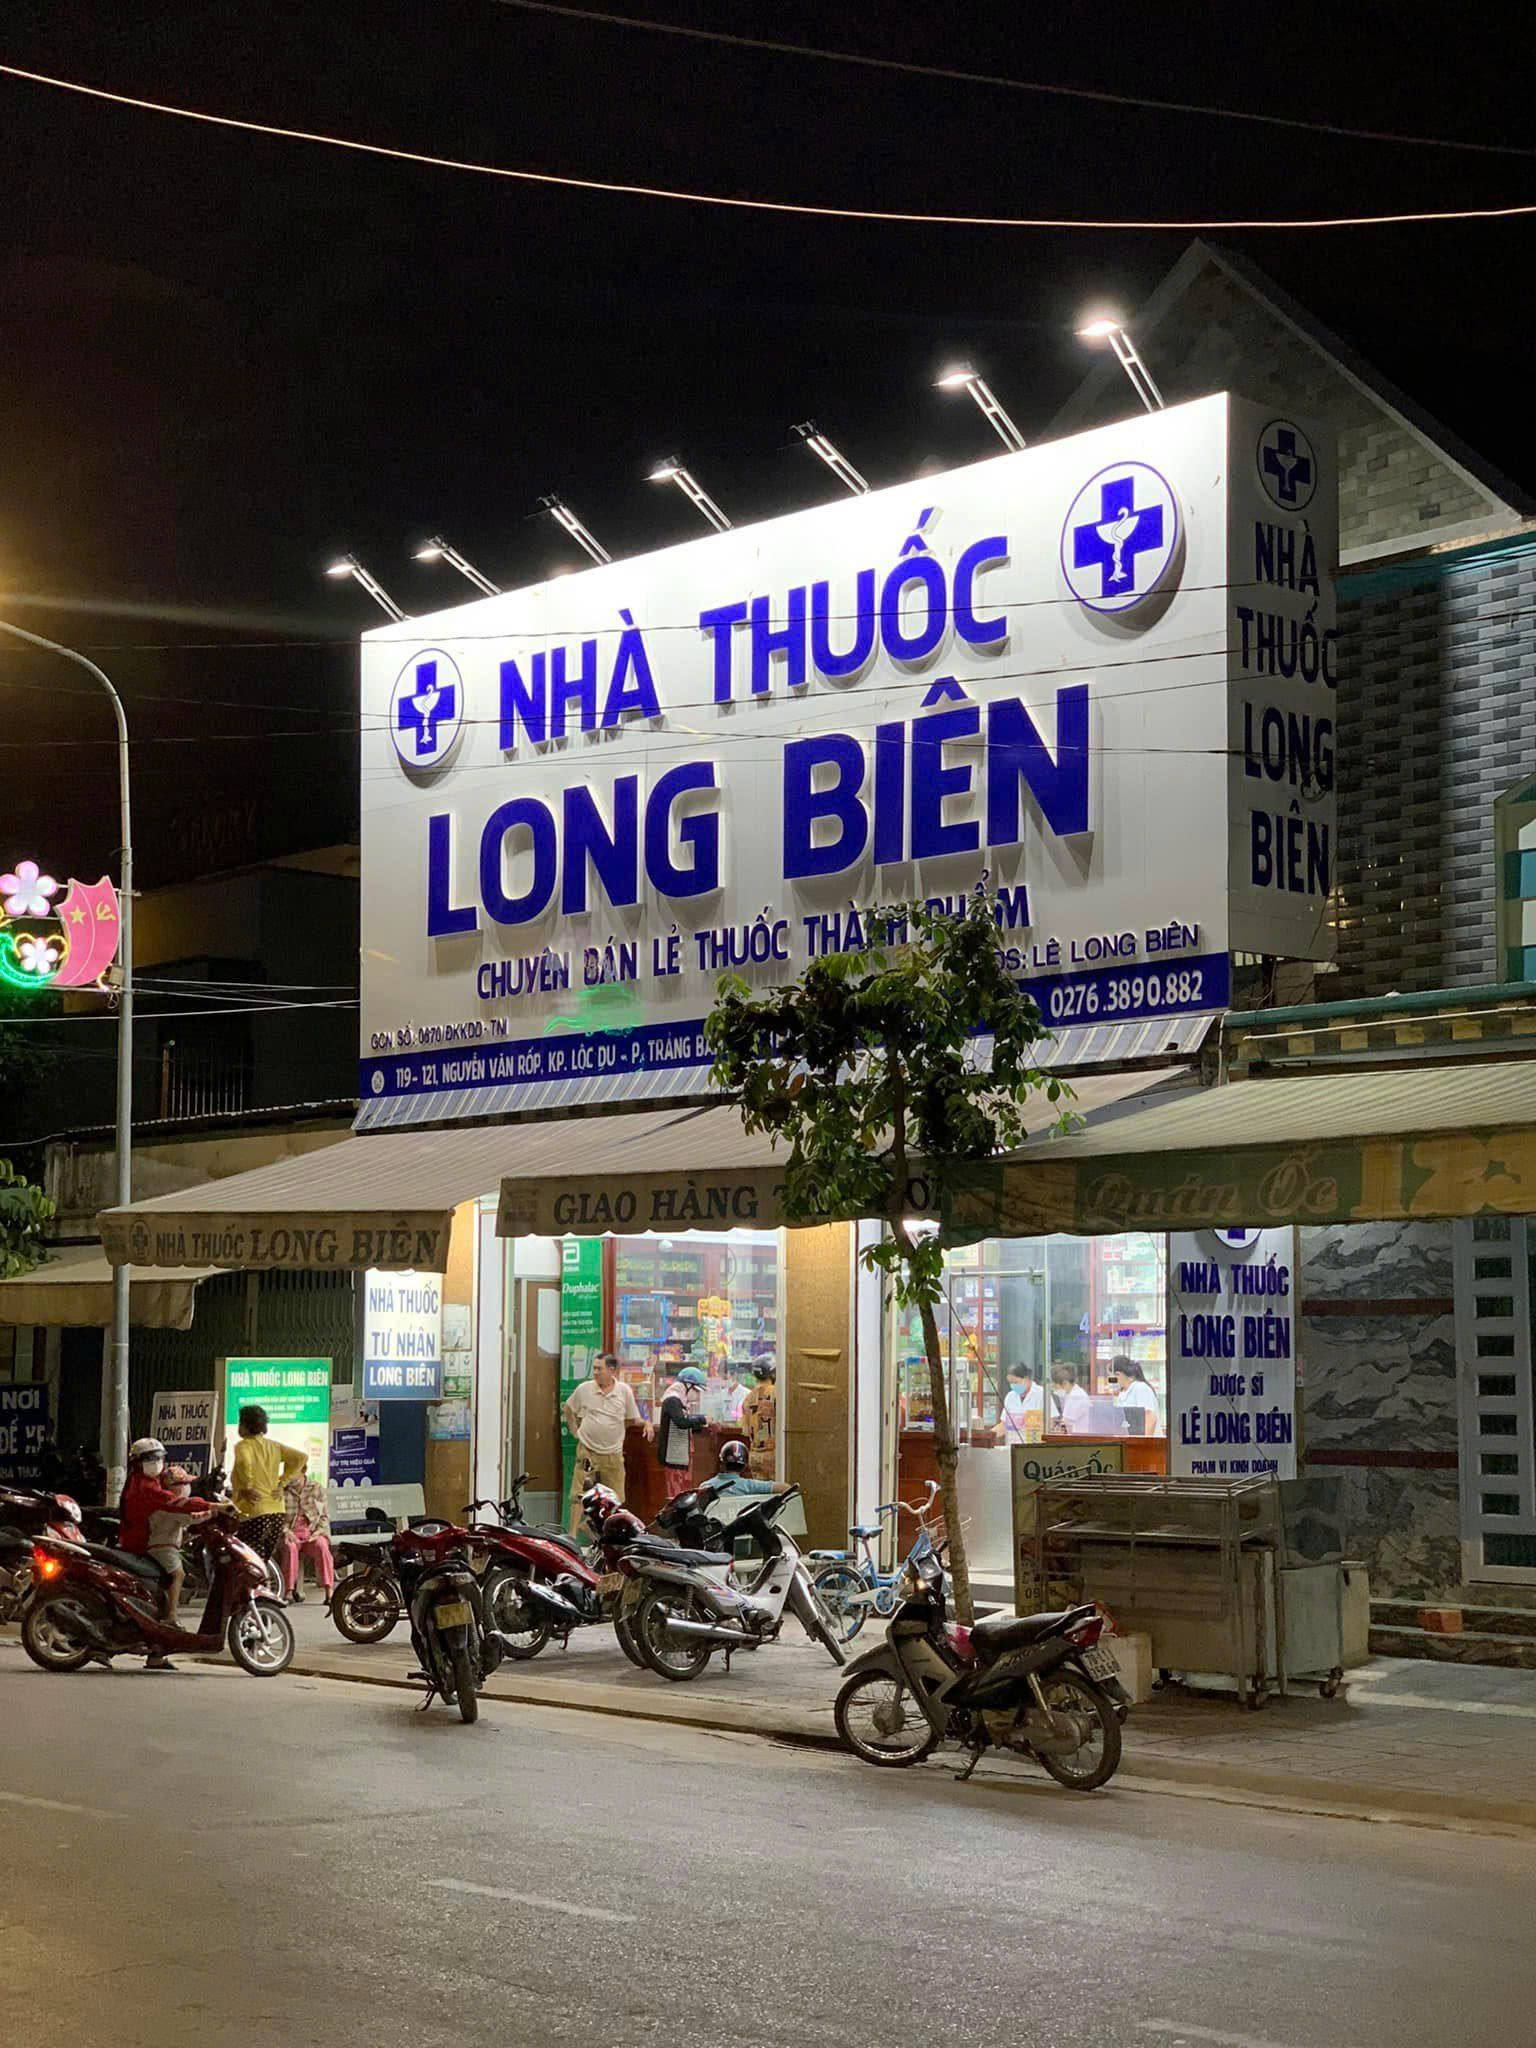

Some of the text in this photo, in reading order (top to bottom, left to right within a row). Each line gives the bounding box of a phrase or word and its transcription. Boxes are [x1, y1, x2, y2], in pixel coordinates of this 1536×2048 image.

[1237, 520, 1340, 689] NHÀ THUỐC
[500, 507, 1008, 751] NHÀ THUỐC
[1245, 702, 1333, 791] LONG
[428, 676, 1089, 937] LONG BIÊN
[1251, 800, 1330, 897] BIÊN
[477, 946, 568, 999] CHUYÊN
[584, 936, 637, 985] BÁN
[653, 924, 680, 976] LẺ
[694, 906, 787, 970] THUỐC
[1033, 938, 1060, 967] LÊ
[1071, 933, 1136, 962] LONG
[1145, 921, 1199, 952] BIÊN
[548, 1050, 567, 1072] KP.
[554, 1191, 636, 1225] GIAO
[649, 1180, 759, 1221] HÀNG
[156, 1220, 440, 1263] NHÀ THUỐC LONG BIÊN
[1181, 1252, 1290, 1296] NHÀ THUỐC
[370, 1281, 438, 1314] NHÀ THUỐC
[372, 1328, 435, 1357] TƯ NHÂN
[1181, 1308, 1290, 1358] LONG BIÊN
[231, 1366, 328, 1387] NHÀ THUỐC LONG BIÊN
[370, 1363, 435, 1386] LONG BIÊN
[1210, 1375, 1245, 1402] DƯỢC
[157, 1427, 182, 1441] LONG
[1181, 1406, 1292, 1444] LÊ LONG BIÊN
